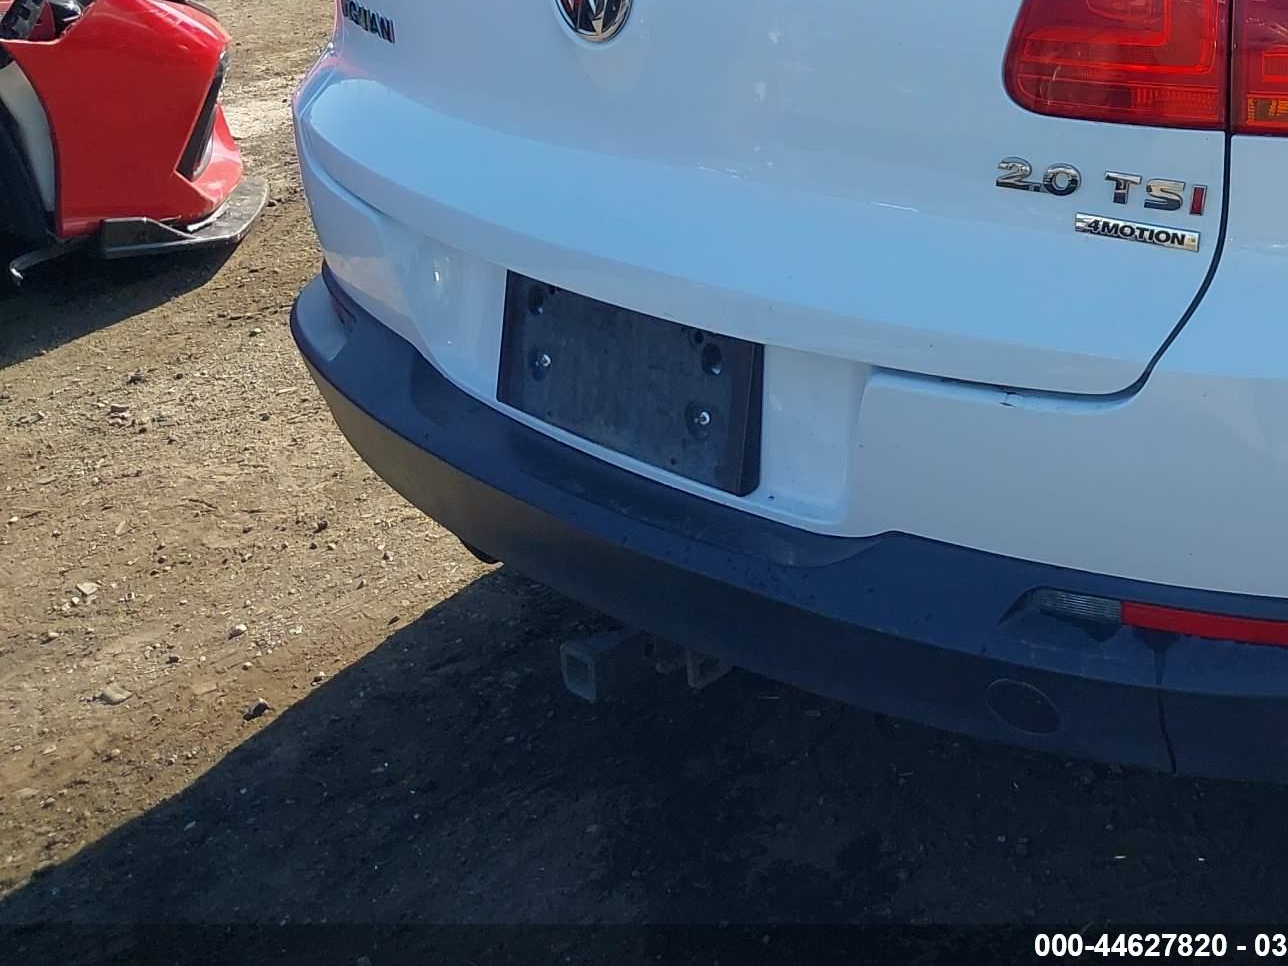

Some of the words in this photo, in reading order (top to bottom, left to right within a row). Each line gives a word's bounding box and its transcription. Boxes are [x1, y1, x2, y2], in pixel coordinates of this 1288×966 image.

[995, 156, 1082, 197] 2.0
[1103, 170, 1208, 216] TSI
[1087, 218, 1187, 247] 4MOTION
